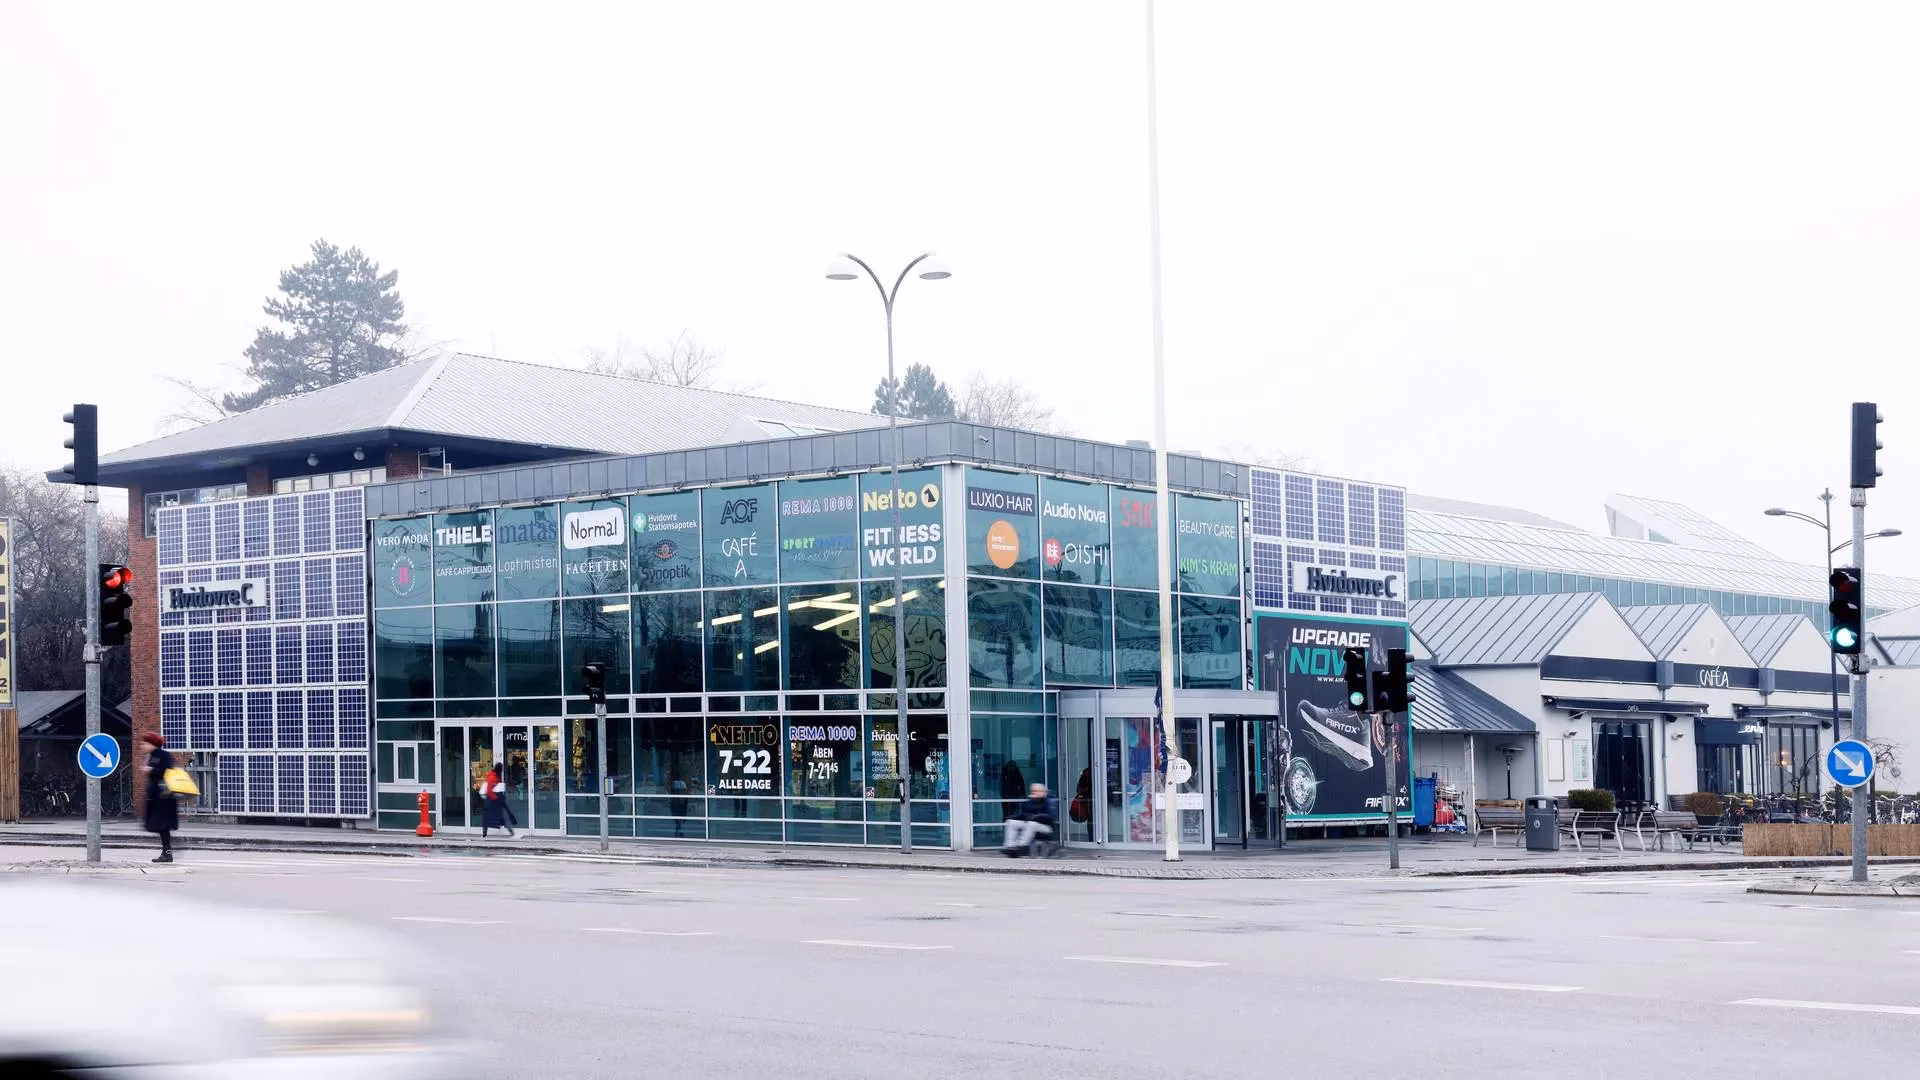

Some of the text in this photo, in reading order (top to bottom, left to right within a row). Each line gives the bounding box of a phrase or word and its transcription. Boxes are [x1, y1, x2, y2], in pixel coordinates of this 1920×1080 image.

[783, 496, 854, 516] REMA 1000
[864, 489, 917, 512] Netto
[970, 491, 1033, 513] LUXIO HAIR
[648, 513, 678, 523] Hvidovre
[720, 498, 758, 525] AOF
[1043, 501, 1106, 523] Audio Nova
[435, 525, 492, 546] THIELE
[499, 519, 558, 544] matas
[570, 517, 618, 541] Normal
[648, 520, 698, 532] Stationsapotek
[1179, 520, 1237, 539] BEAUTY CARE
[377, 534, 429, 546] VERO MODA
[721, 531, 758, 558] CAFÉ
[868, 545, 937, 567] WORLD
[1064, 543, 1108, 566] OISHI
[565, 559, 628, 575] FACETTEN
[641, 564, 690, 581] Synoptik
[734, 560, 748, 578] A
[1180, 557, 1237, 577] KIM'S KRAM
[1307, 567, 1398, 599] Hvidovre C
[169, 583, 254, 610] Hvidovre C
[1291, 627, 1372, 648] UPGRADE
[714, 724, 778, 746] NETTO
[789, 726, 857, 741] REMA 1000
[871, 730, 910, 741] Hvidov
[1325, 717, 1358, 734] AIRTOX
[719, 749, 772, 774] 7-22
[812, 744, 834, 759] ÅBEN
[718, 778, 772, 790] ALLE DAGE
[1364, 796, 1406, 808] AIRX
